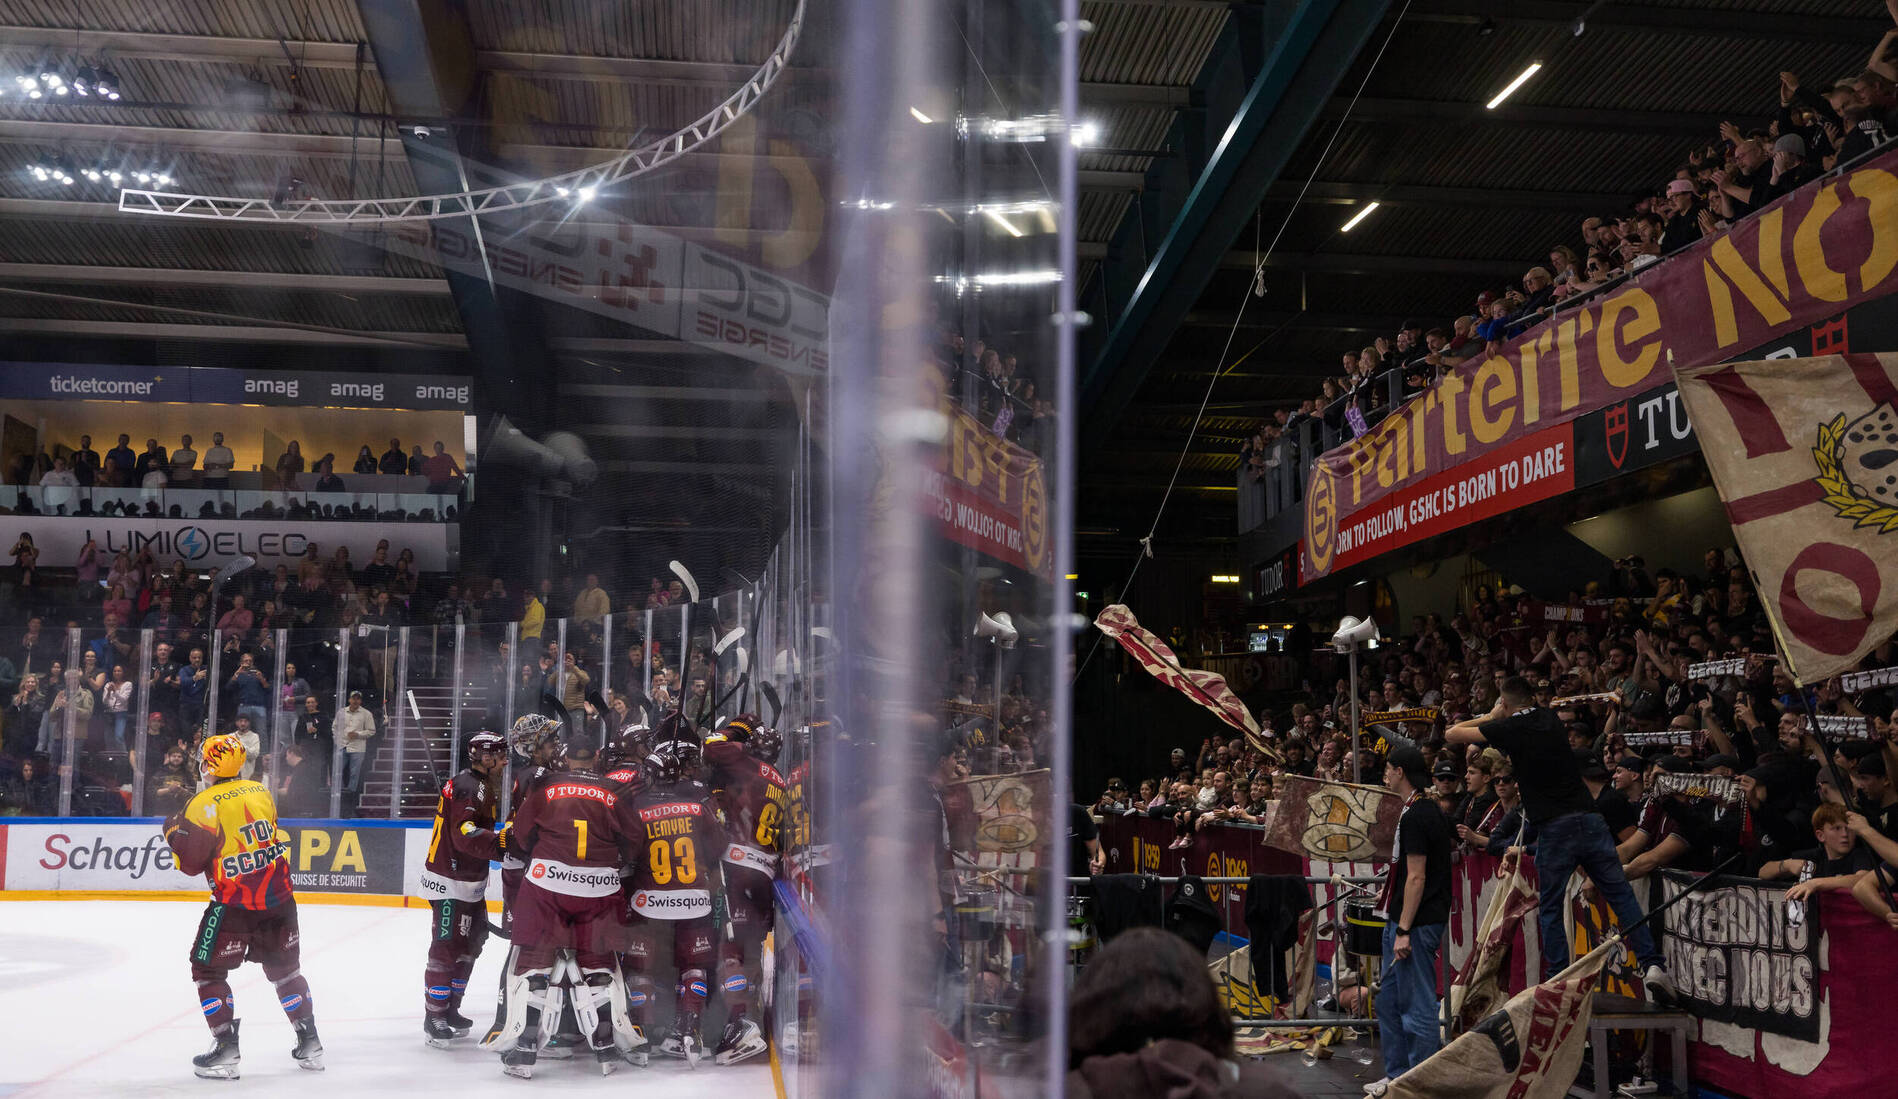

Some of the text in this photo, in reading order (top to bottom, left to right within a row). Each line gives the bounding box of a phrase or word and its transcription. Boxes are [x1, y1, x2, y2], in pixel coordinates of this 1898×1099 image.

[50, 375, 153, 395] ticketcorner
[244, 378, 299, 398] amag
[330, 381, 384, 401] amag
[415, 384, 469, 404] amag
[1350, 287, 1662, 505] Parterre
[1336, 441, 1566, 555] ORN TO FOLLOW, GSHC IS BORN TO DARE
[1260, 560, 1284, 596] TUDOR
[558, 786, 605, 802] TUDOR
[645, 805, 689, 819] TUDOR
[646, 817, 693, 840] LEMYRE
[573, 819, 588, 860] 1
[39, 834, 178, 879] Schafe
[649, 836, 697, 885] 93
[319, 874, 328, 886] DE
